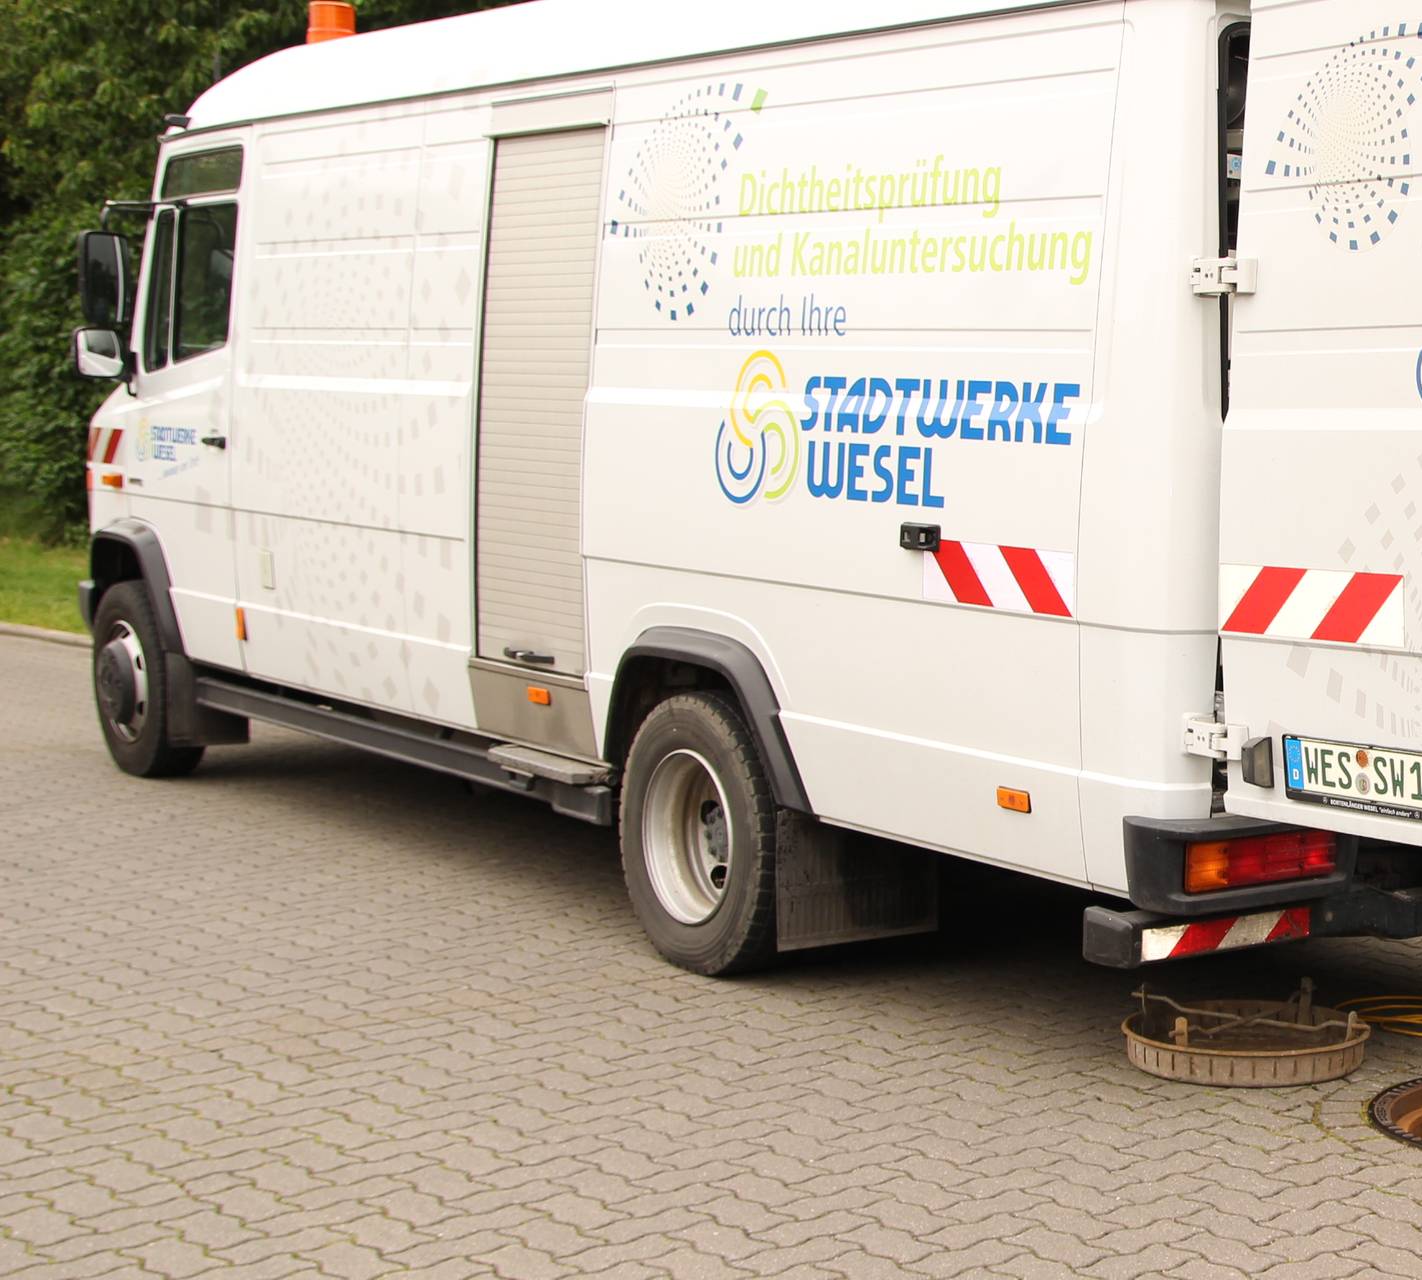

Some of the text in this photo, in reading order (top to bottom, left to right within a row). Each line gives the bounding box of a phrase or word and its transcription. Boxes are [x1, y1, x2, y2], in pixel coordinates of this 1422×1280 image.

[739, 154, 1002, 224] Dichtheitsprüfung
[733, 219, 1092, 285] und Kanaluntersuchung
[728, 293, 847, 336] durch Ihre
[800, 376, 1080, 446] STADTWERKE
[806, 440, 945, 508] WESEL
[1304, 746, 1352, 790] WES
